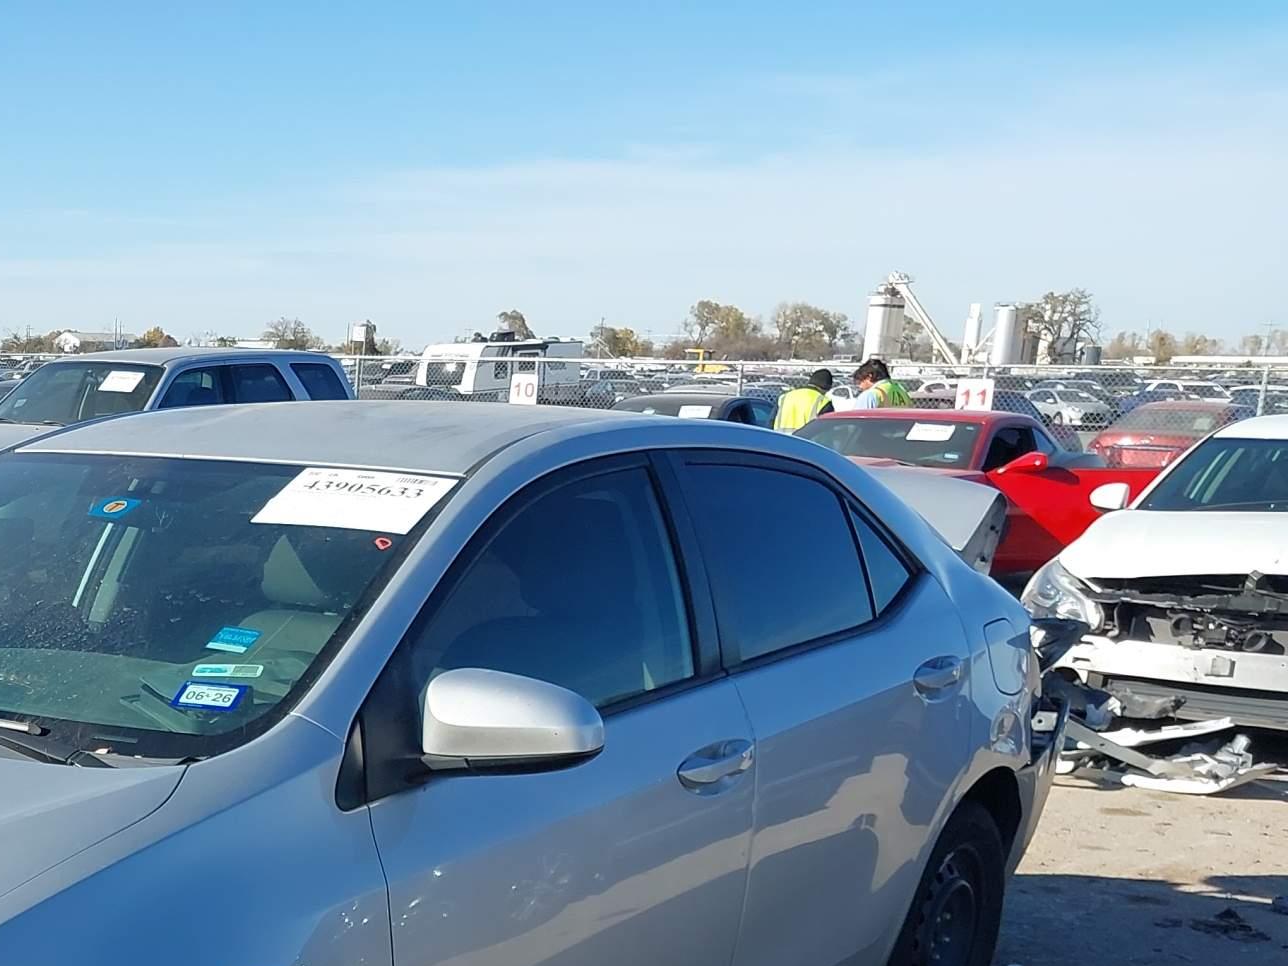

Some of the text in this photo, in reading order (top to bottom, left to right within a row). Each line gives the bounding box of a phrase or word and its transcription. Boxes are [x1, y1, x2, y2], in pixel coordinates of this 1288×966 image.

[514, 382, 535, 398] 10
[961, 388, 987, 406] 11
[303, 479, 424, 499] 43905633
[185, 690, 233, 703] 06 26
